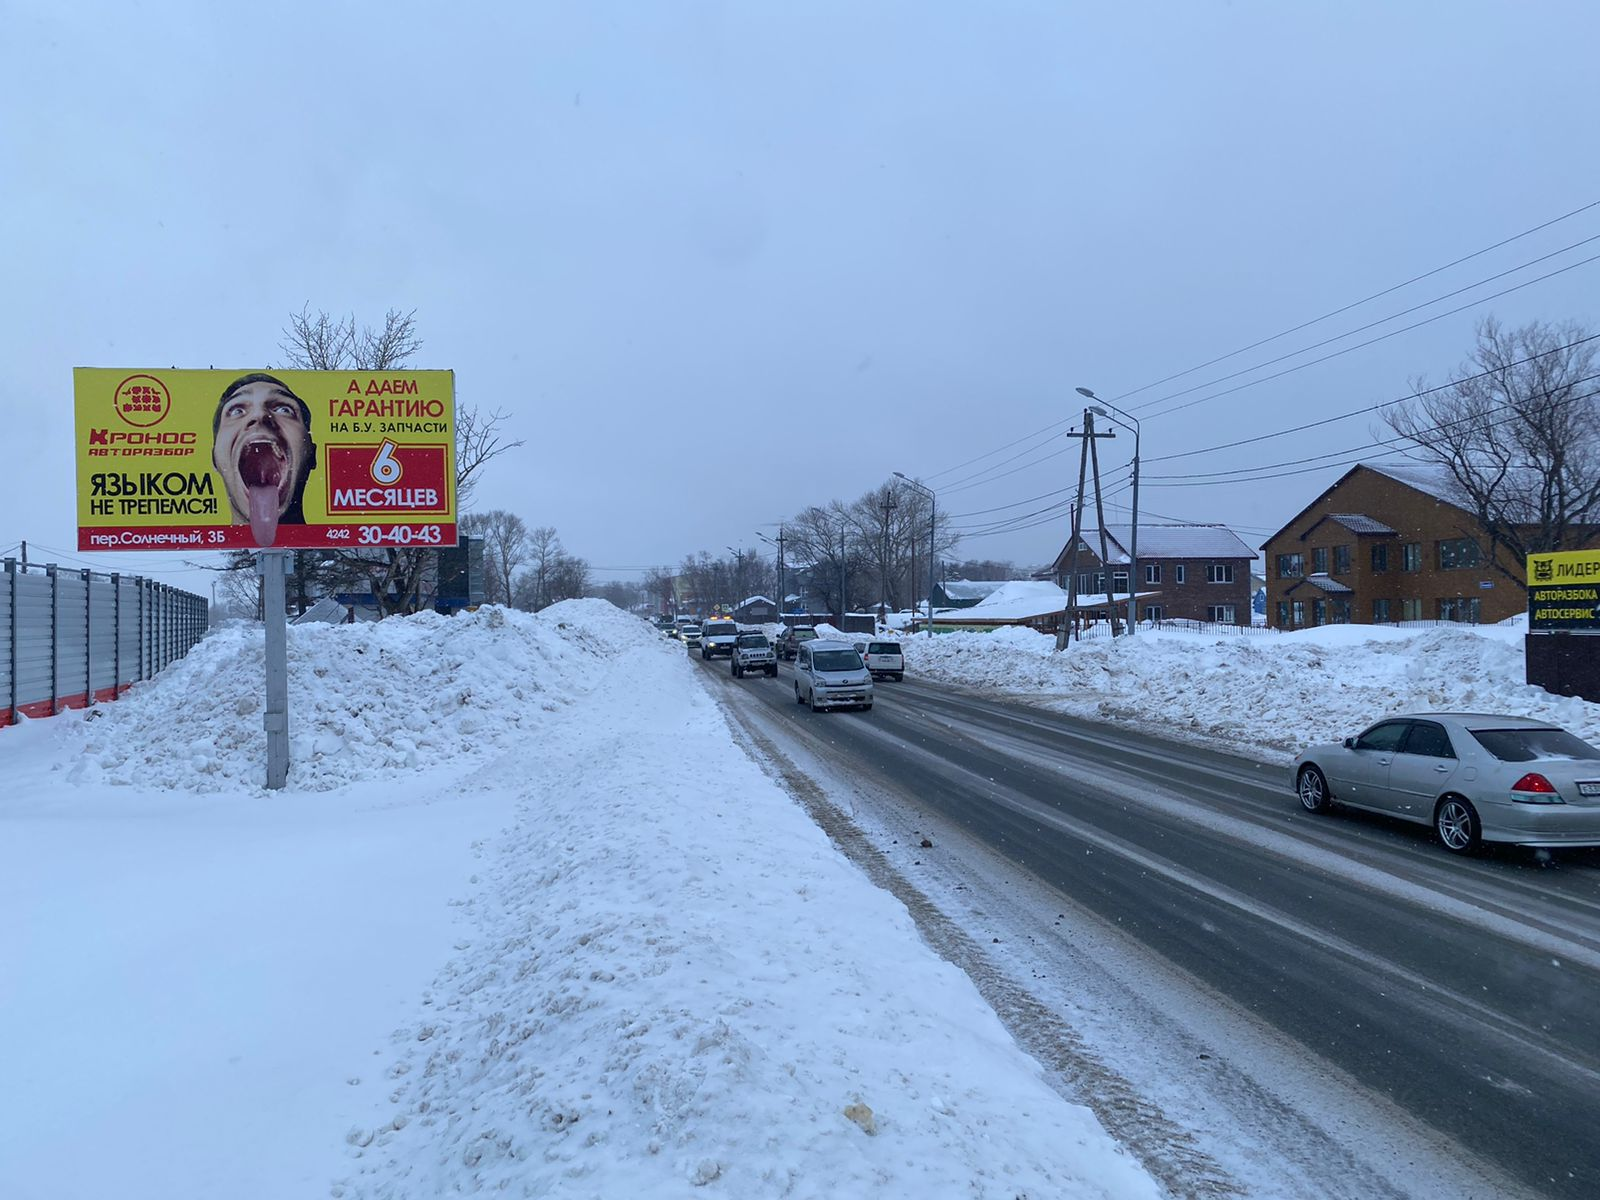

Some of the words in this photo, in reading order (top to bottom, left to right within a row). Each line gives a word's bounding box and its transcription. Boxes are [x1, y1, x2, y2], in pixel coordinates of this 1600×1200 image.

[347, 379, 361, 394] А
[365, 379, 418, 396] ДАЕМ
[329, 399, 444, 418] ГАРАНТИЮ
[330, 422, 349, 433] НА
[353, 422, 376, 433] Б.У.
[380, 422, 448, 433] ЗАПЧАСТИ
[88, 448, 195, 457] АВТОРАЗБОР
[370, 436, 403, 486] 6
[90, 472, 214, 496] ЯЗЫКОМ
[91, 499, 114, 515] НЕ
[119, 498, 218, 515] ТРЕПЕМСЯ!
[333, 488, 439, 508] МЕСЯЦЕВ
[207, 530, 226, 543] 3Б
[326, 529, 351, 540] 4242
[358, 525, 442, 544] 30-40-43
[1556, 562, 1600, 577] ЛИДЕР
[1535, 608, 1596, 620] АВТОСЕРВИС
